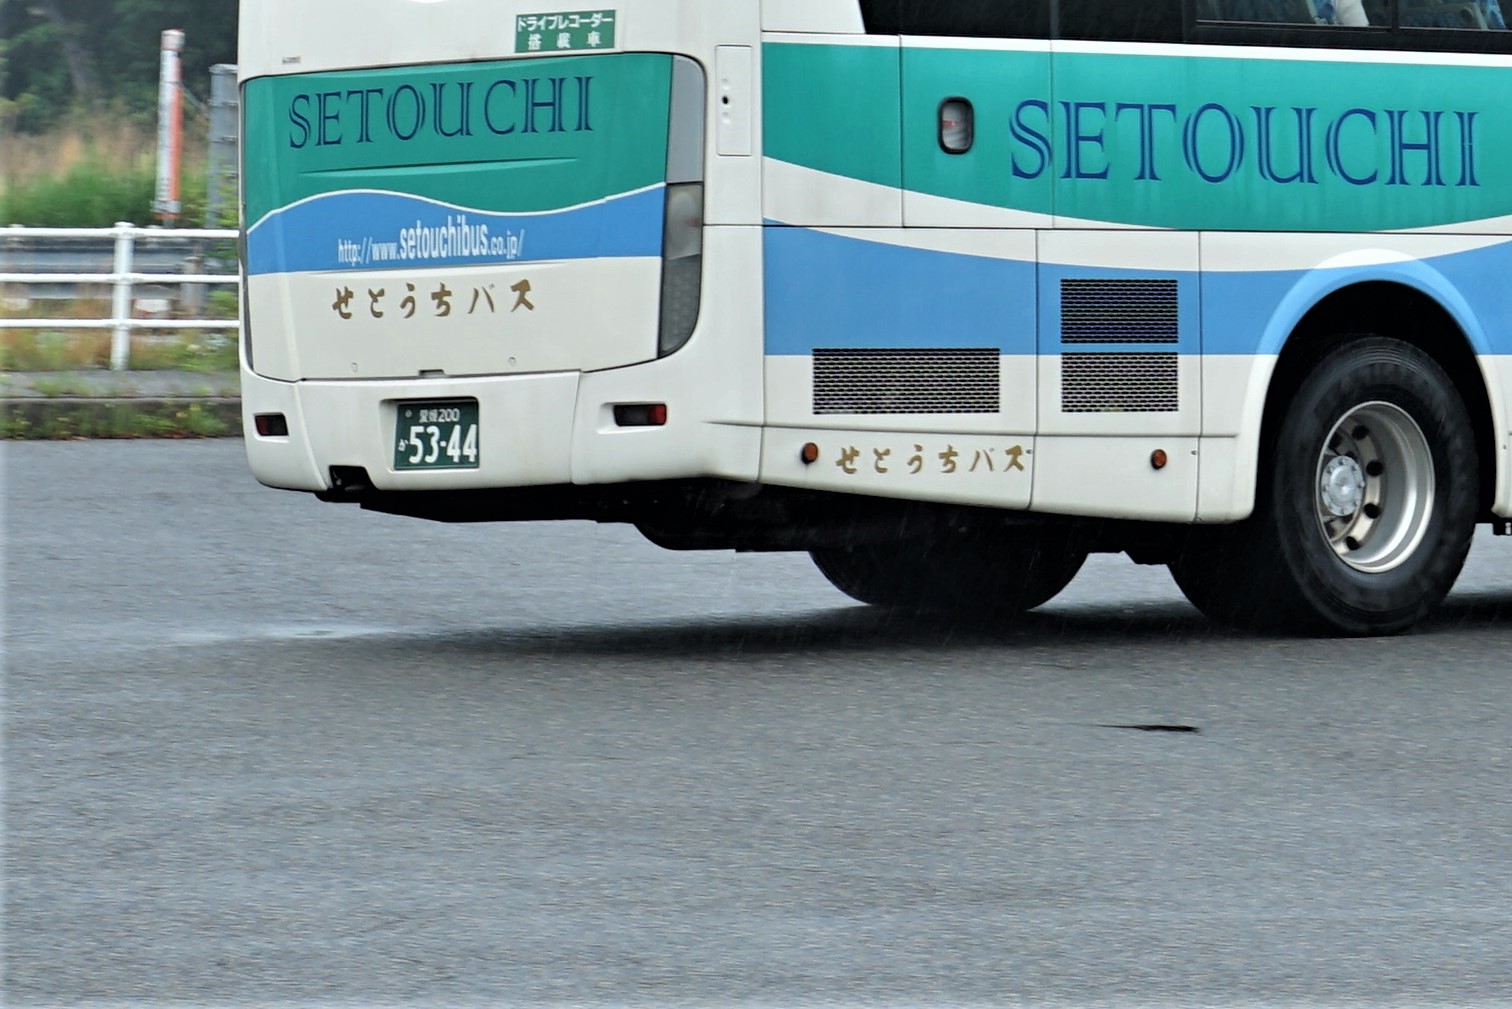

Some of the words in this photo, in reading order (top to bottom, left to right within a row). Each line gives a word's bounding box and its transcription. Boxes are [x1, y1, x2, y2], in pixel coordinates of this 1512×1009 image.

[288, 76, 594, 149] SETOUCHI
[1008, 98, 1481, 187] SETOUCHI
[338, 215, 525, 266] http://www.setouchibus.co.jp/
[332, 279, 534, 319] せとうちバス
[409, 424, 477, 464] 53-44
[836, 444, 1024, 474] せとうちバス
